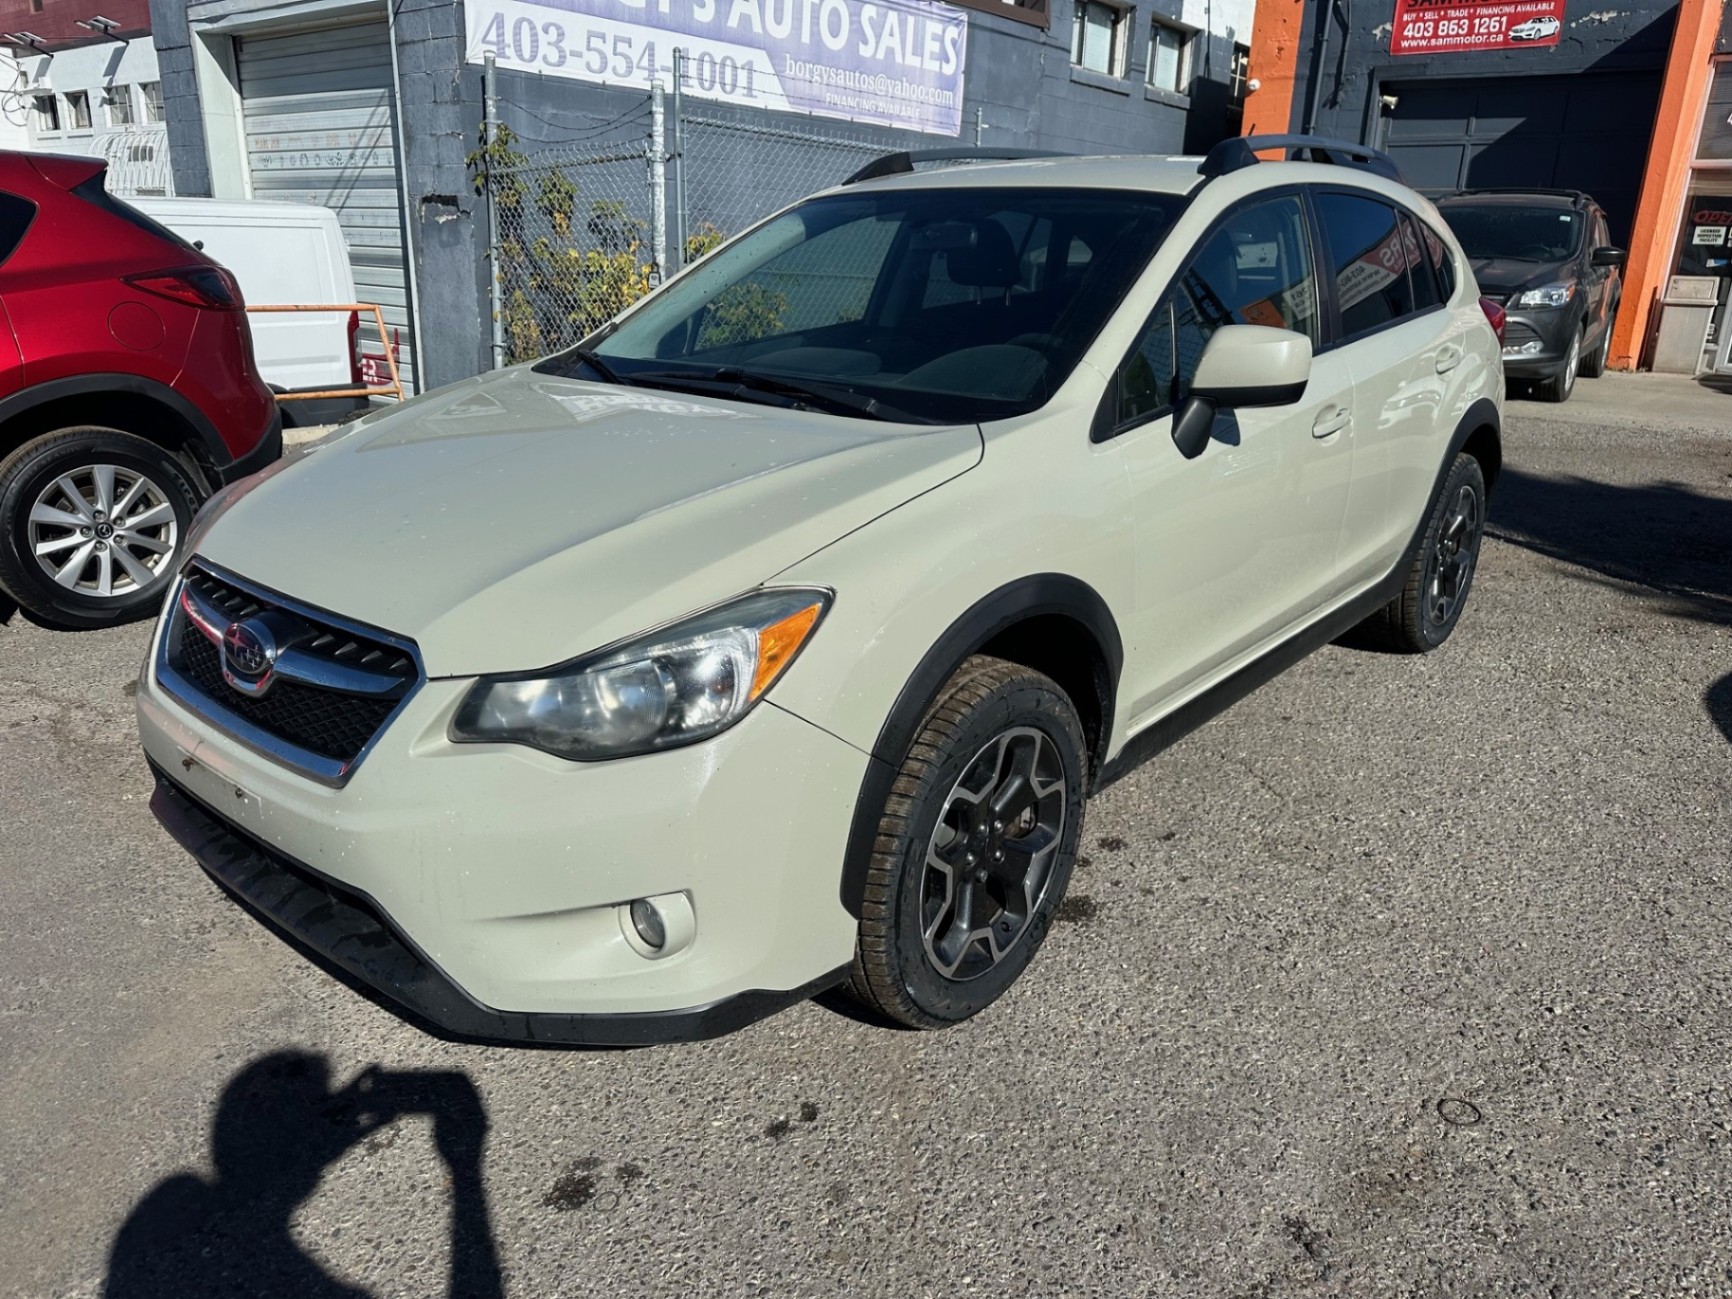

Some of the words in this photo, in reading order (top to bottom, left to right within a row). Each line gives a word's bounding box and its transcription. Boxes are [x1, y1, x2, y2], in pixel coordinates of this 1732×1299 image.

[1402, 13, 1417, 22] BUY
[1423, 11, 1439, 20] SELL
[1447, 8, 1469, 18] TRADE
[1476, 5, 1515, 16] FINANCING
[1516, 2, 1555, 13] AVAILABLE
[1403, 21, 1434, 38] 403
[1437, 19, 1469, 36] 863
[1473, 16, 1508, 33] 1261
[481, 11, 757, 99] 403-554-1001
[727, 0, 850, 51] AUTO
[858, 4, 958, 76] SALES
[1401, 33, 1504, 48] www.sammotor.ca
[784, 53, 954, 105] borgysautos@yahoo.com
